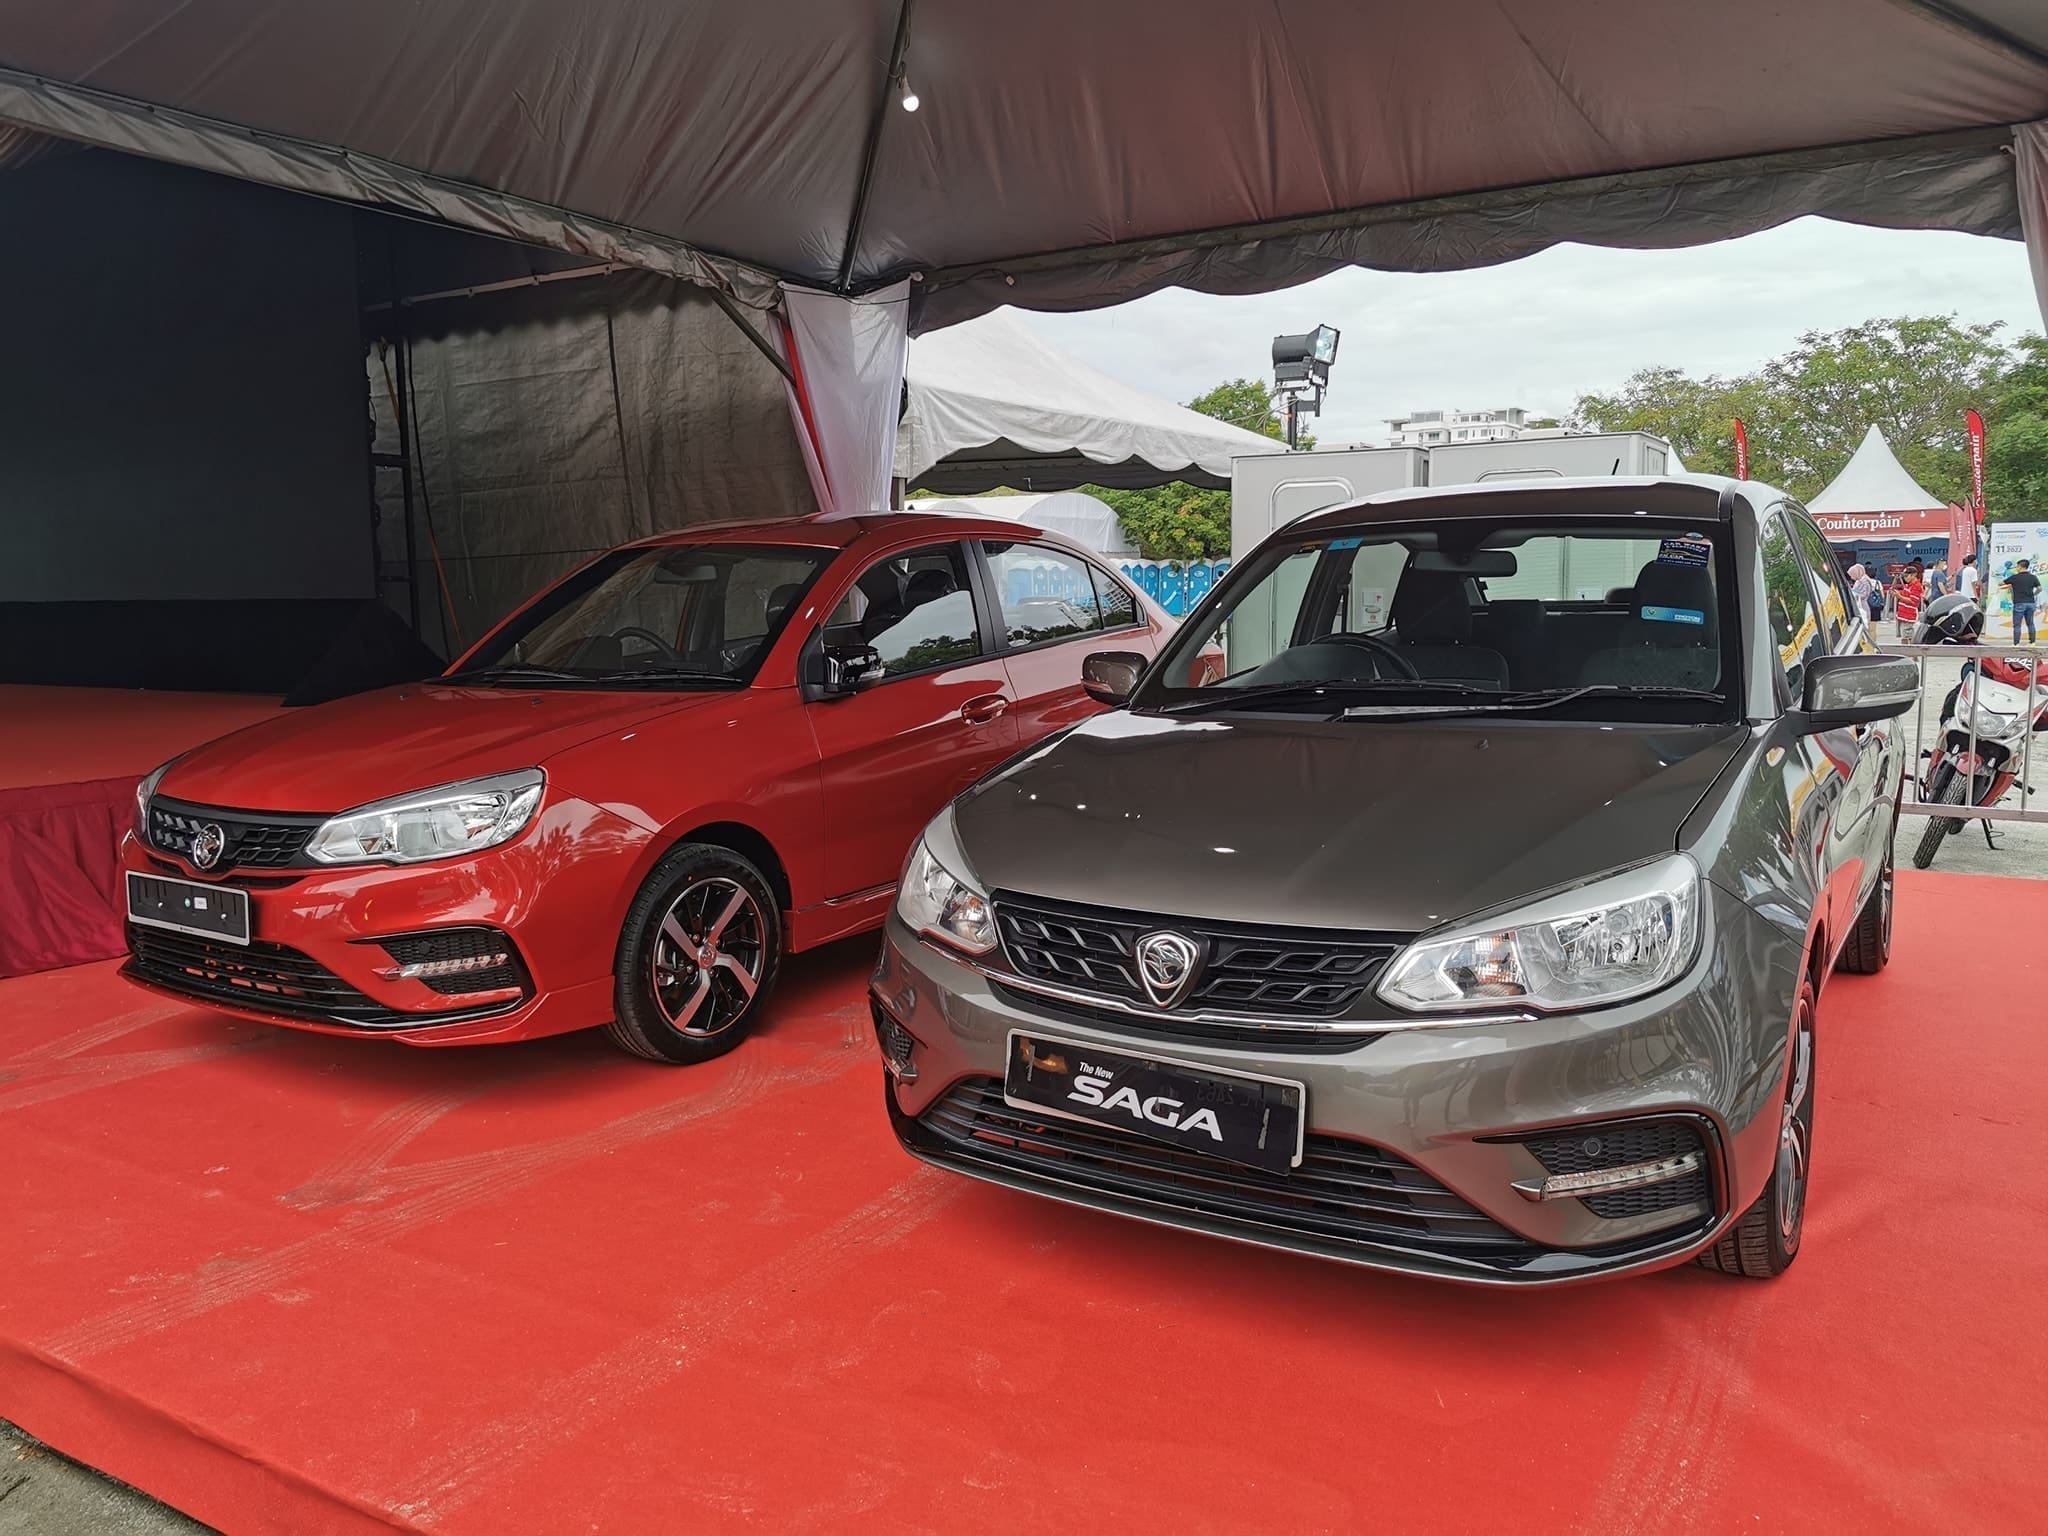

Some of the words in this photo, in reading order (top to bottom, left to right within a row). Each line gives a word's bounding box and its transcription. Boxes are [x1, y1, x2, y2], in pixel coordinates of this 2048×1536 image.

[1816, 516, 1900, 531] Counterpain
[1079, 1062, 1096, 1075] The
[1096, 1065, 1114, 1080] New
[1066, 1075, 1223, 1142] SAGA
